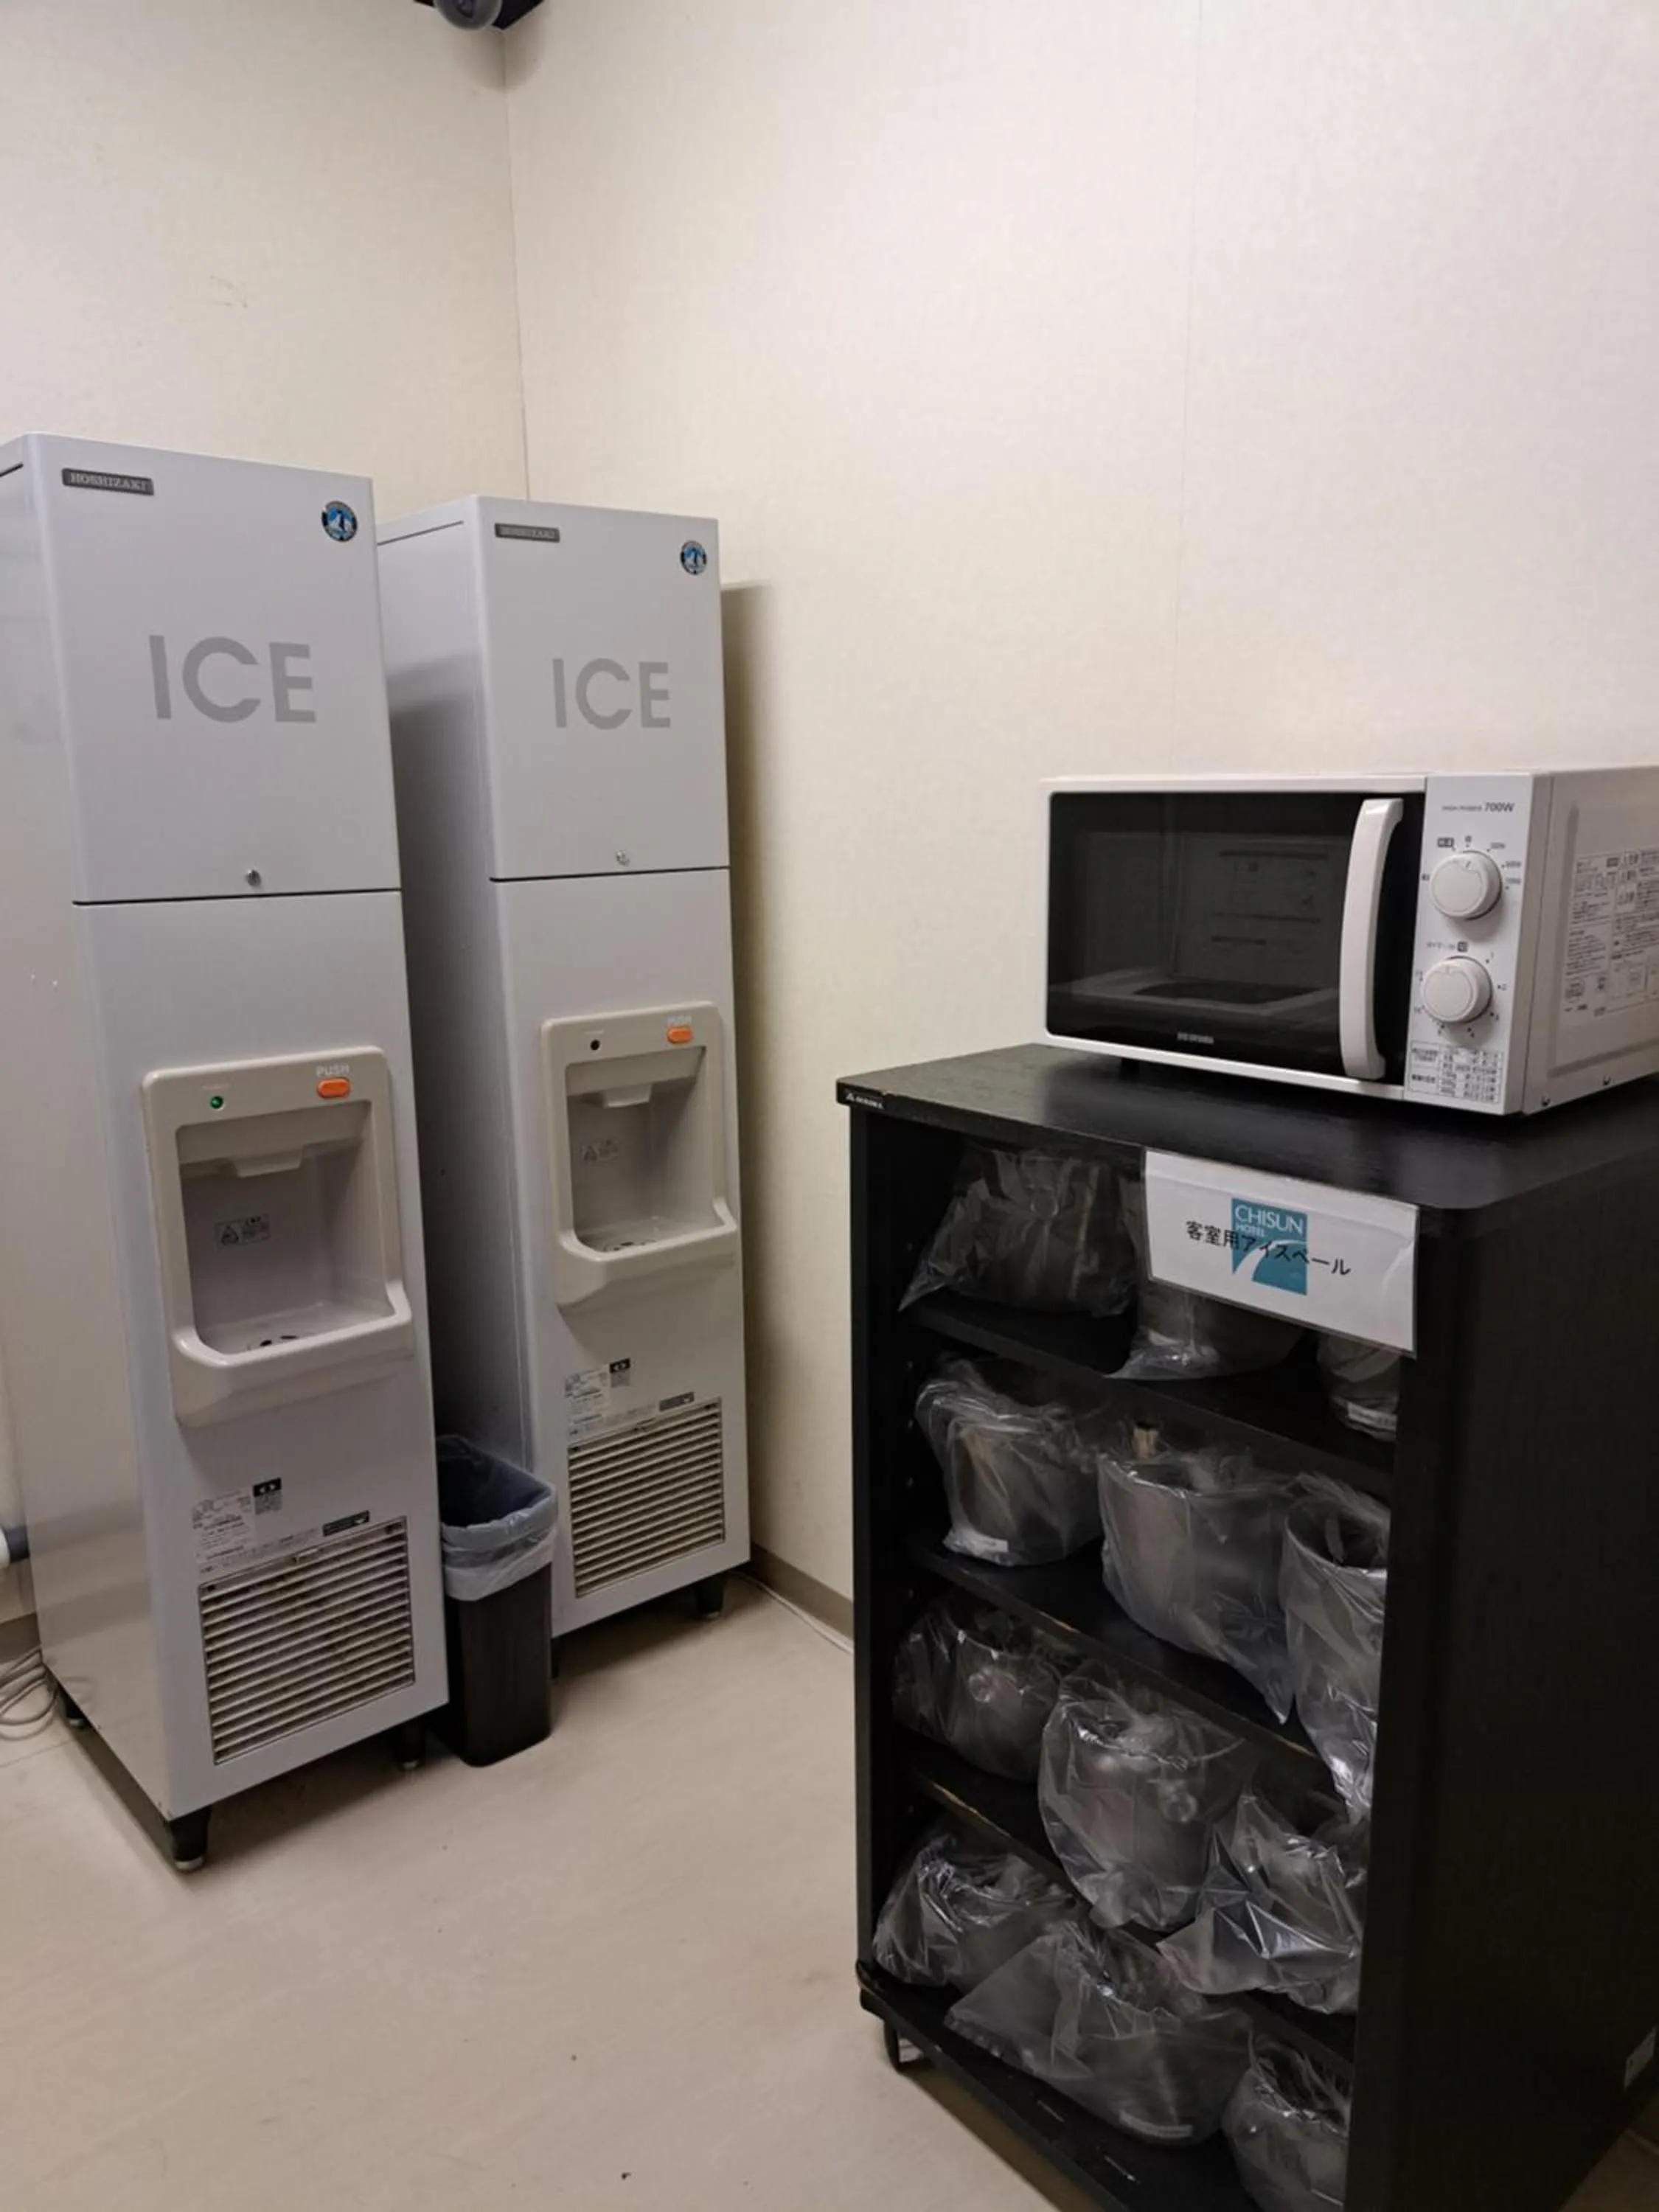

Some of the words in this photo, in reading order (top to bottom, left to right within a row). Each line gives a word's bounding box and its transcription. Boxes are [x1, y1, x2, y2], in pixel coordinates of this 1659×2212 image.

[149, 634, 316, 723] ICE
[552, 657, 672, 730] ICE
[1484, 801, 1515, 813] 700W
[316, 1064, 349, 1077] PUSH
[1234, 1204, 1304, 1235] CHISUN
[1235, 1222, 1266, 1238] HOTEL
